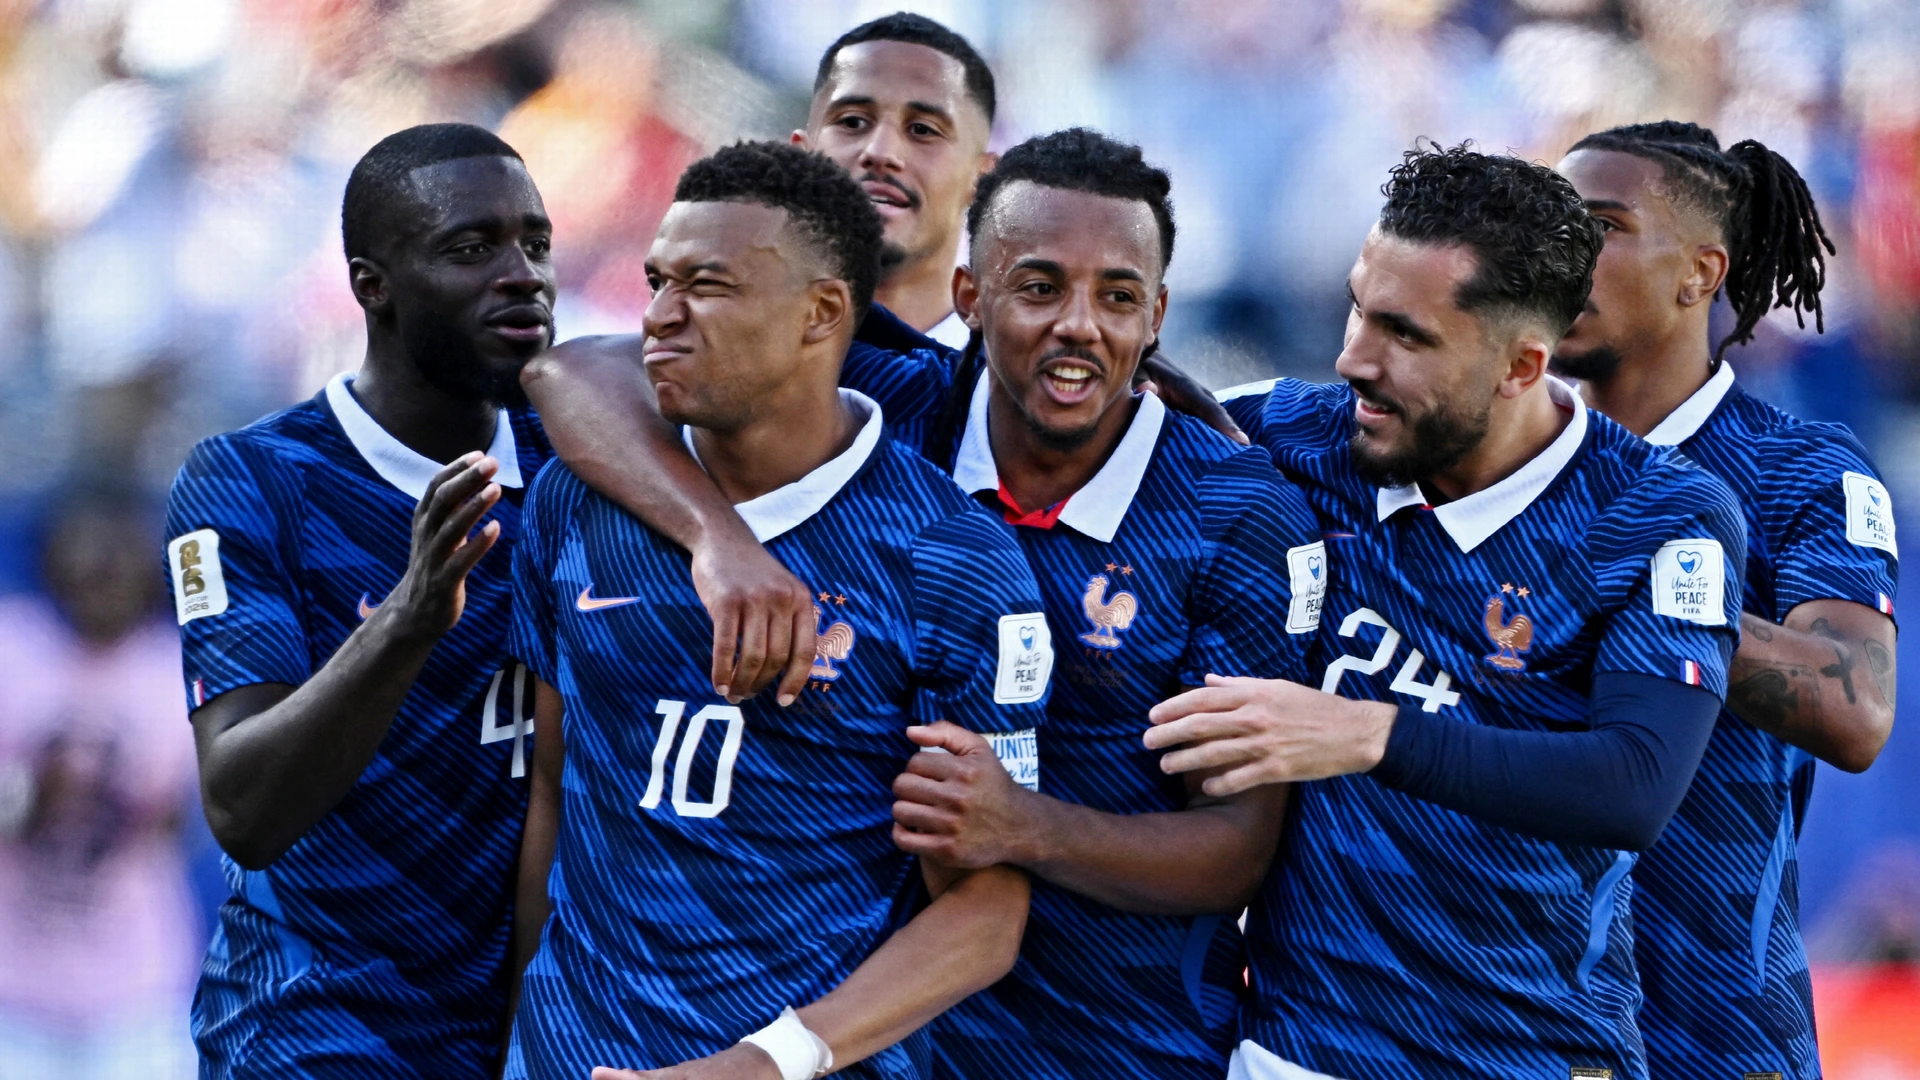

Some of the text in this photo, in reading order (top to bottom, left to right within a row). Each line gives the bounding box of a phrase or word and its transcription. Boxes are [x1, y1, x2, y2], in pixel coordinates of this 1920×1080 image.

[1671, 576, 1695, 591] Unite
[1305, 597, 1325, 613] PEAC
[1675, 591, 1707, 605] PEACE
[1321, 607, 1461, 714] 24
[811, 681, 831, 693] FF
[480, 663, 535, 778] 4
[639, 699, 744, 818] 10
